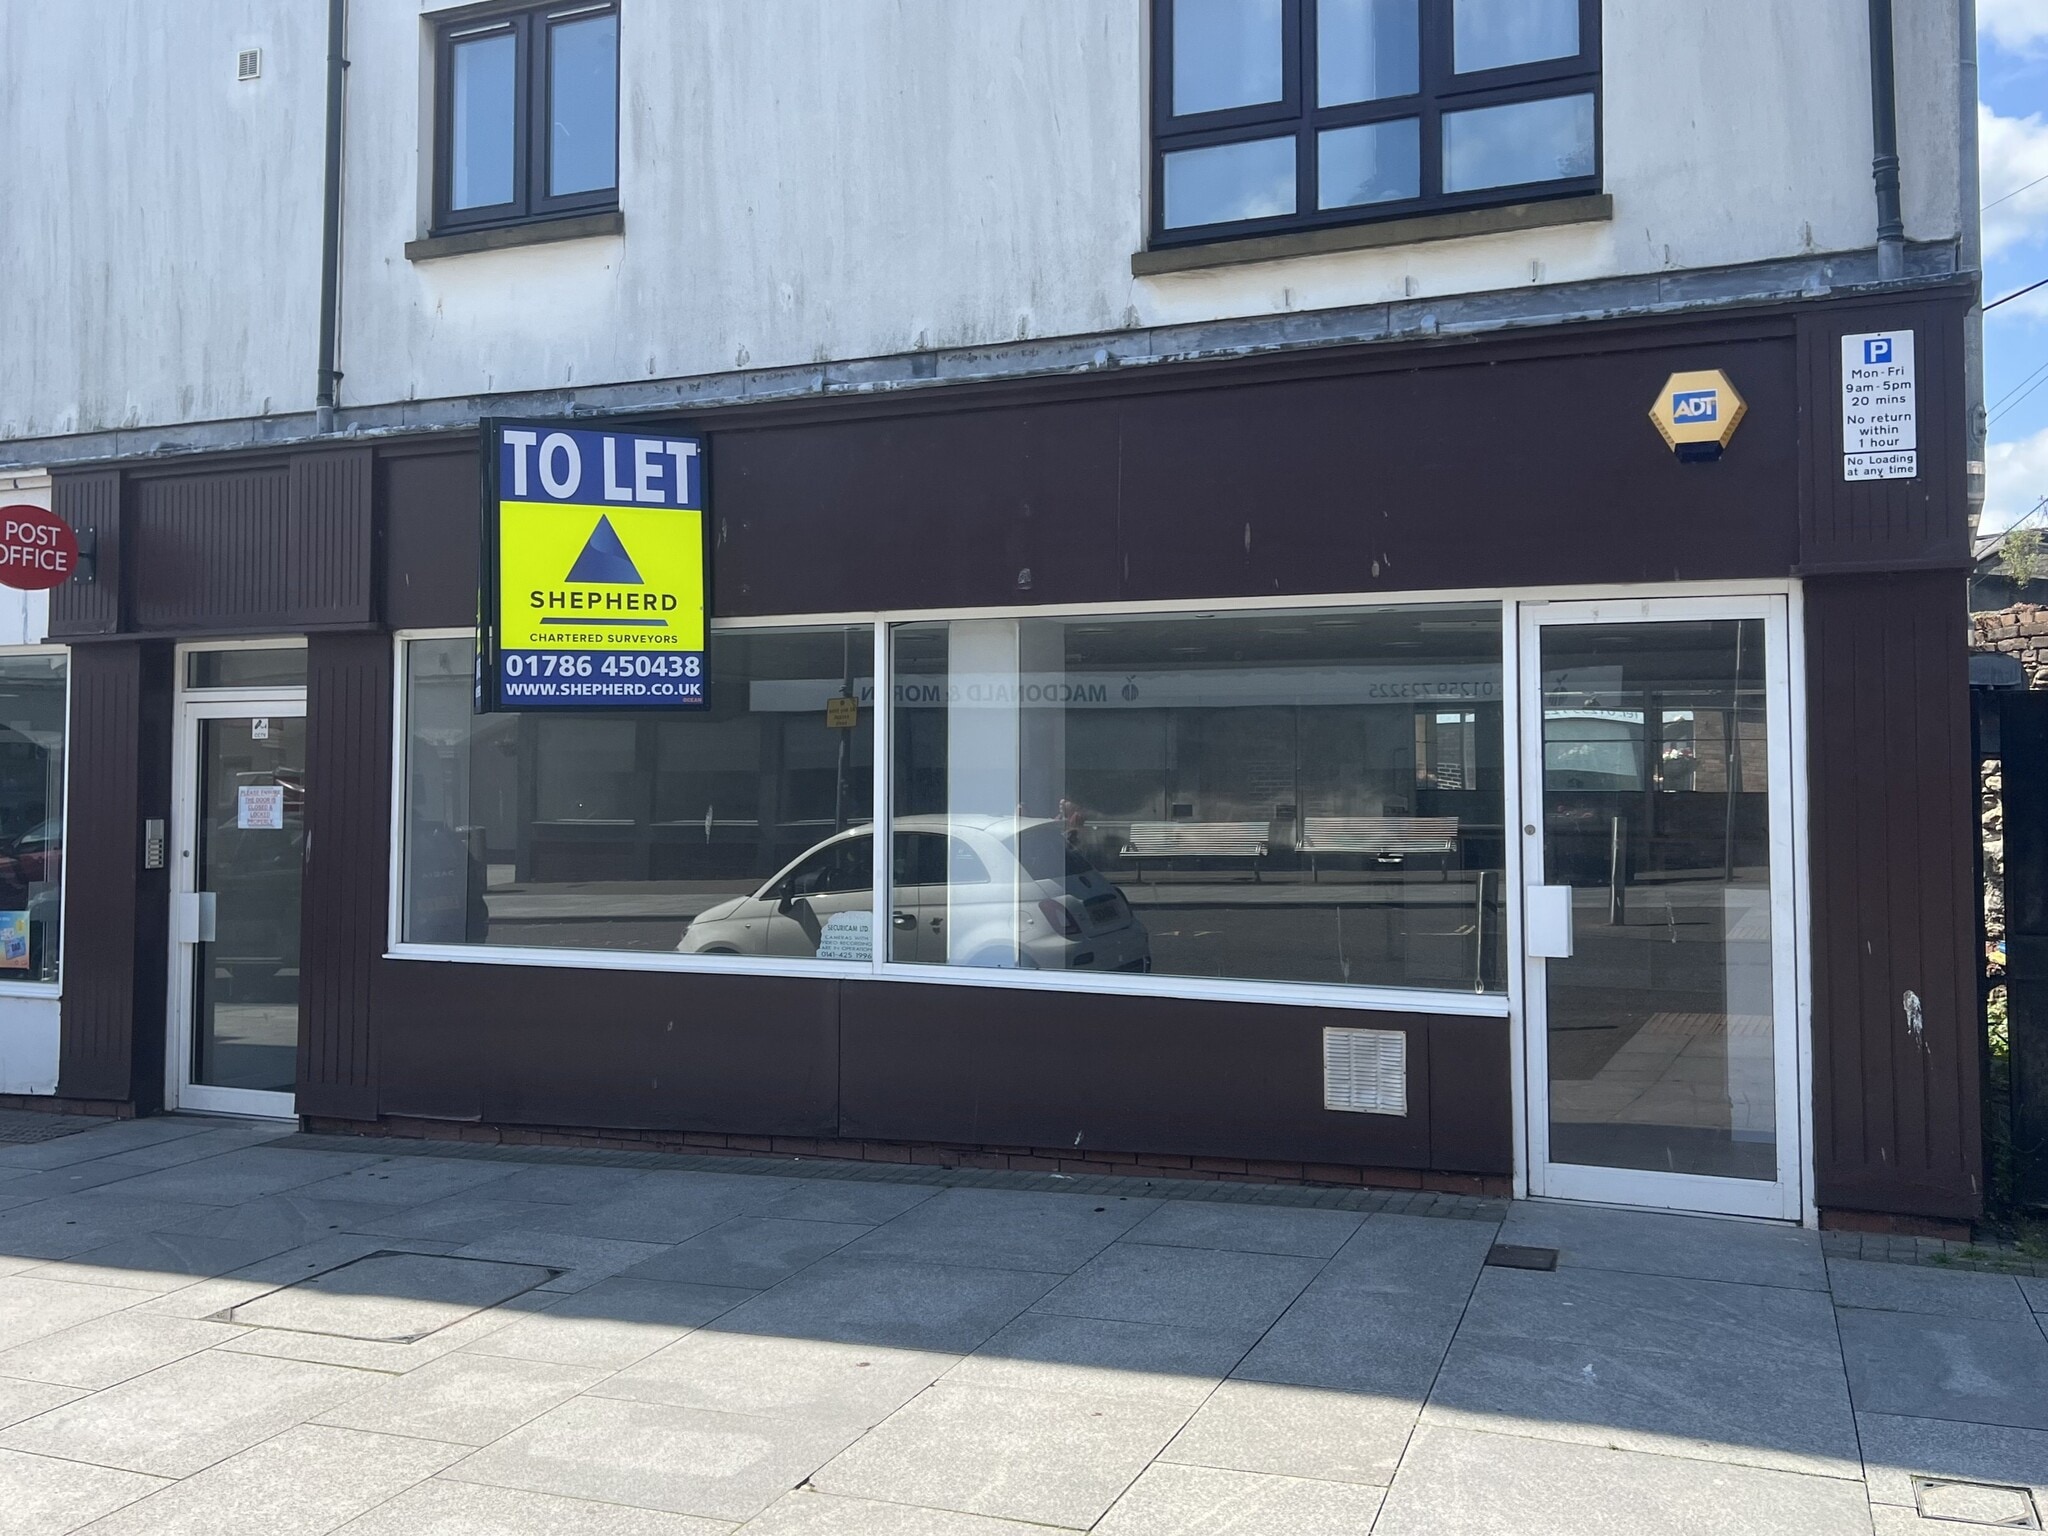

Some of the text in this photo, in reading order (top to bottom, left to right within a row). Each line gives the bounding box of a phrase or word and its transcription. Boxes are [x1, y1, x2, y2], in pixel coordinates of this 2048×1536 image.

[1870, 340, 1888, 363] P
[1851, 395, 1906, 406] 20 mins
[1674, 397, 1715, 417] ADT
[1847, 413, 1912, 424] No return
[1859, 425, 1899, 436] within
[1859, 438, 1900, 448] 1 hour
[1847, 454, 1914, 465] No Loading
[503, 430, 697, 504] TO LET
[1847, 465, 1914, 476] at any time
[6, 521, 60, 546] POST
[530, 590, 677, 611] SHEPHERD
[529, 633, 678, 644] CHARTERED SURVEYORS
[505, 654, 592, 677] 01786
[600, 655, 700, 678] 450438
[505, 683, 701, 696] WWW.SHEPHERD.CO.UK
